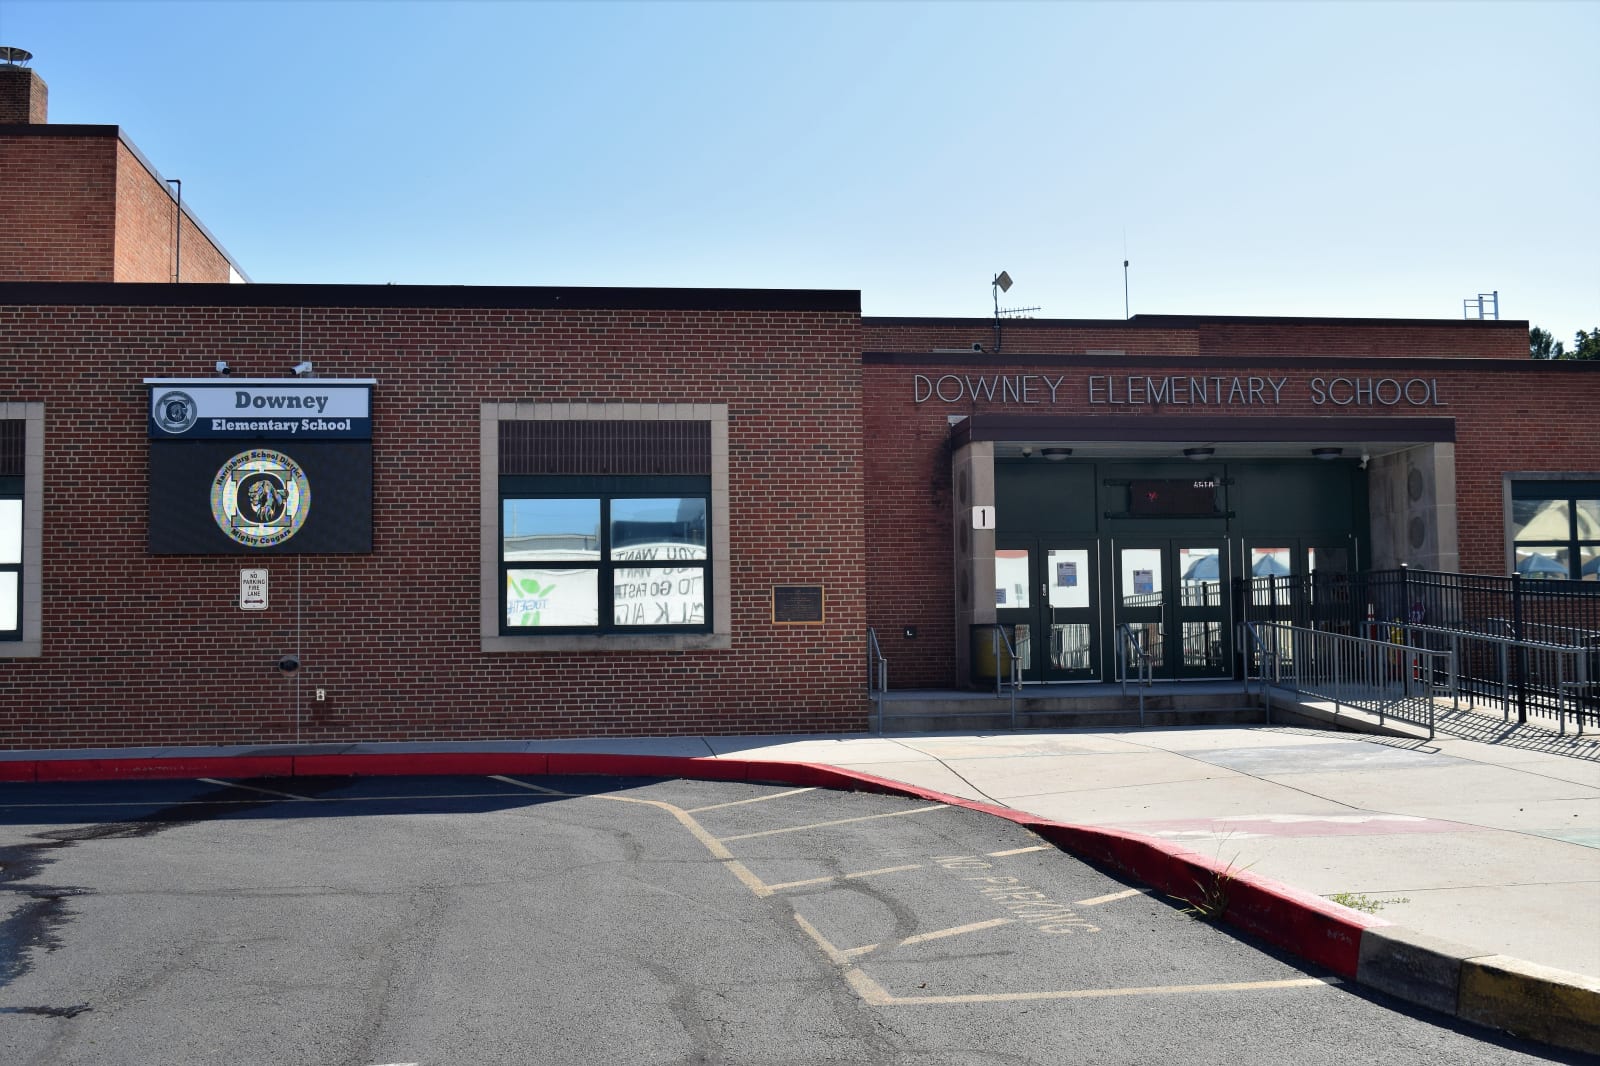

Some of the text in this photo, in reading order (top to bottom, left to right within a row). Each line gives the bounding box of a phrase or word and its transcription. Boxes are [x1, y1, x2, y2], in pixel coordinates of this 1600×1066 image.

[914, 374, 1449, 406] DOWNEY ELEMENTARY SCHOOL
[235, 391, 329, 414] Downey
[211, 418, 351, 434] Elementary School
[250, 450, 279, 461] School
[279, 455, 303, 479] District
[980, 507, 986, 528] 1
[230, 527, 292, 546] Mighty Cougars
[958, 876, 1102, 935] PARKING
